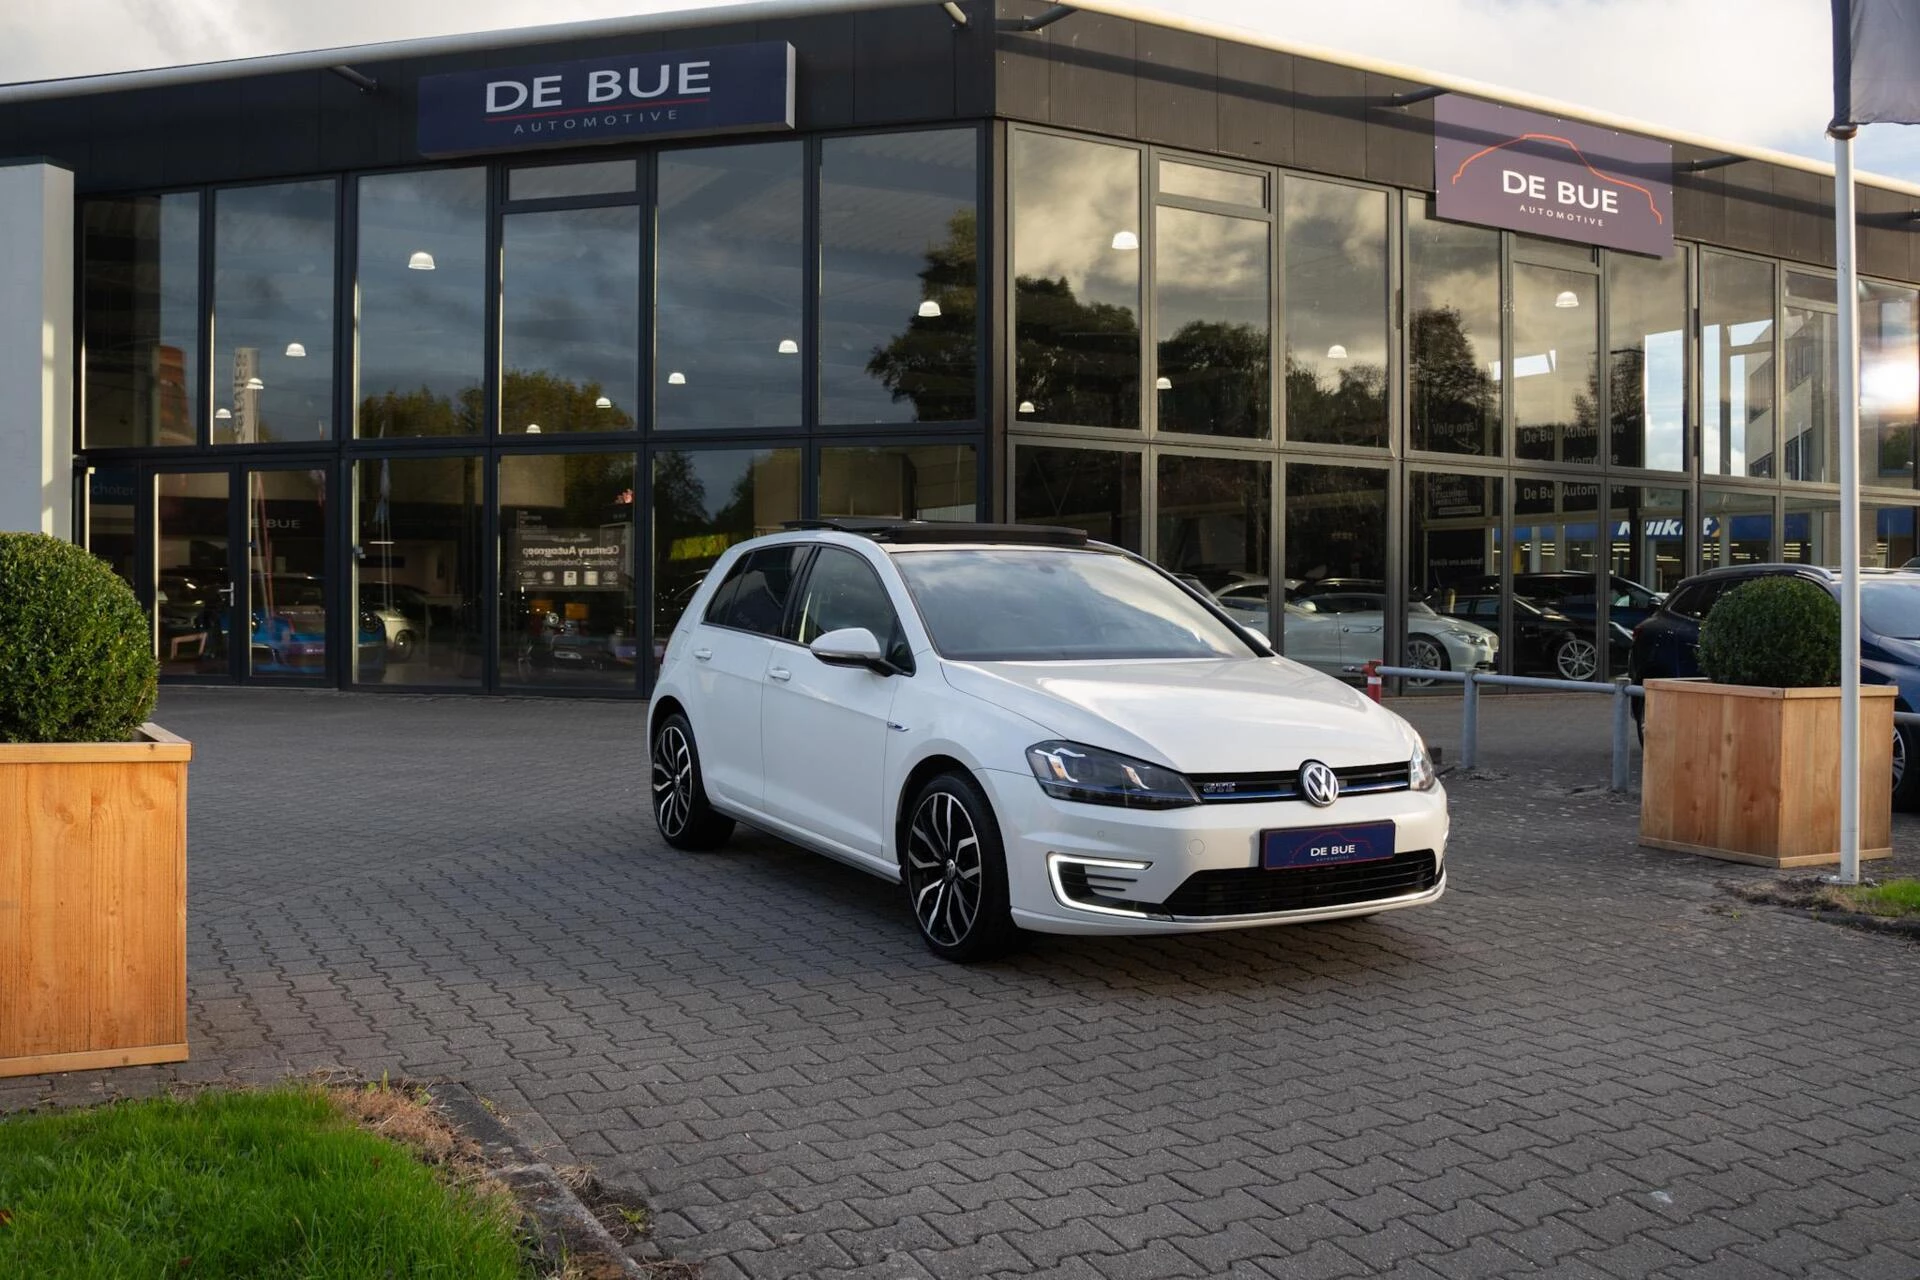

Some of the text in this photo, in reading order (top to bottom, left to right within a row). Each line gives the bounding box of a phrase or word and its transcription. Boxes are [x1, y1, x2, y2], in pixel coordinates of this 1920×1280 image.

[485, 60, 711, 114] DE BUE
[513, 109, 678, 135] AUTOMOTIVE
[1502, 169, 1619, 215] DE BUE
[1519, 204, 1605, 227] AUTOMOTIVE
[1524, 424, 1625, 444] De Bu Automve
[1523, 484, 1625, 500] De Bu Automve
[267, 517, 301, 529] BUE
[1310, 844, 1356, 857] DE BUE
